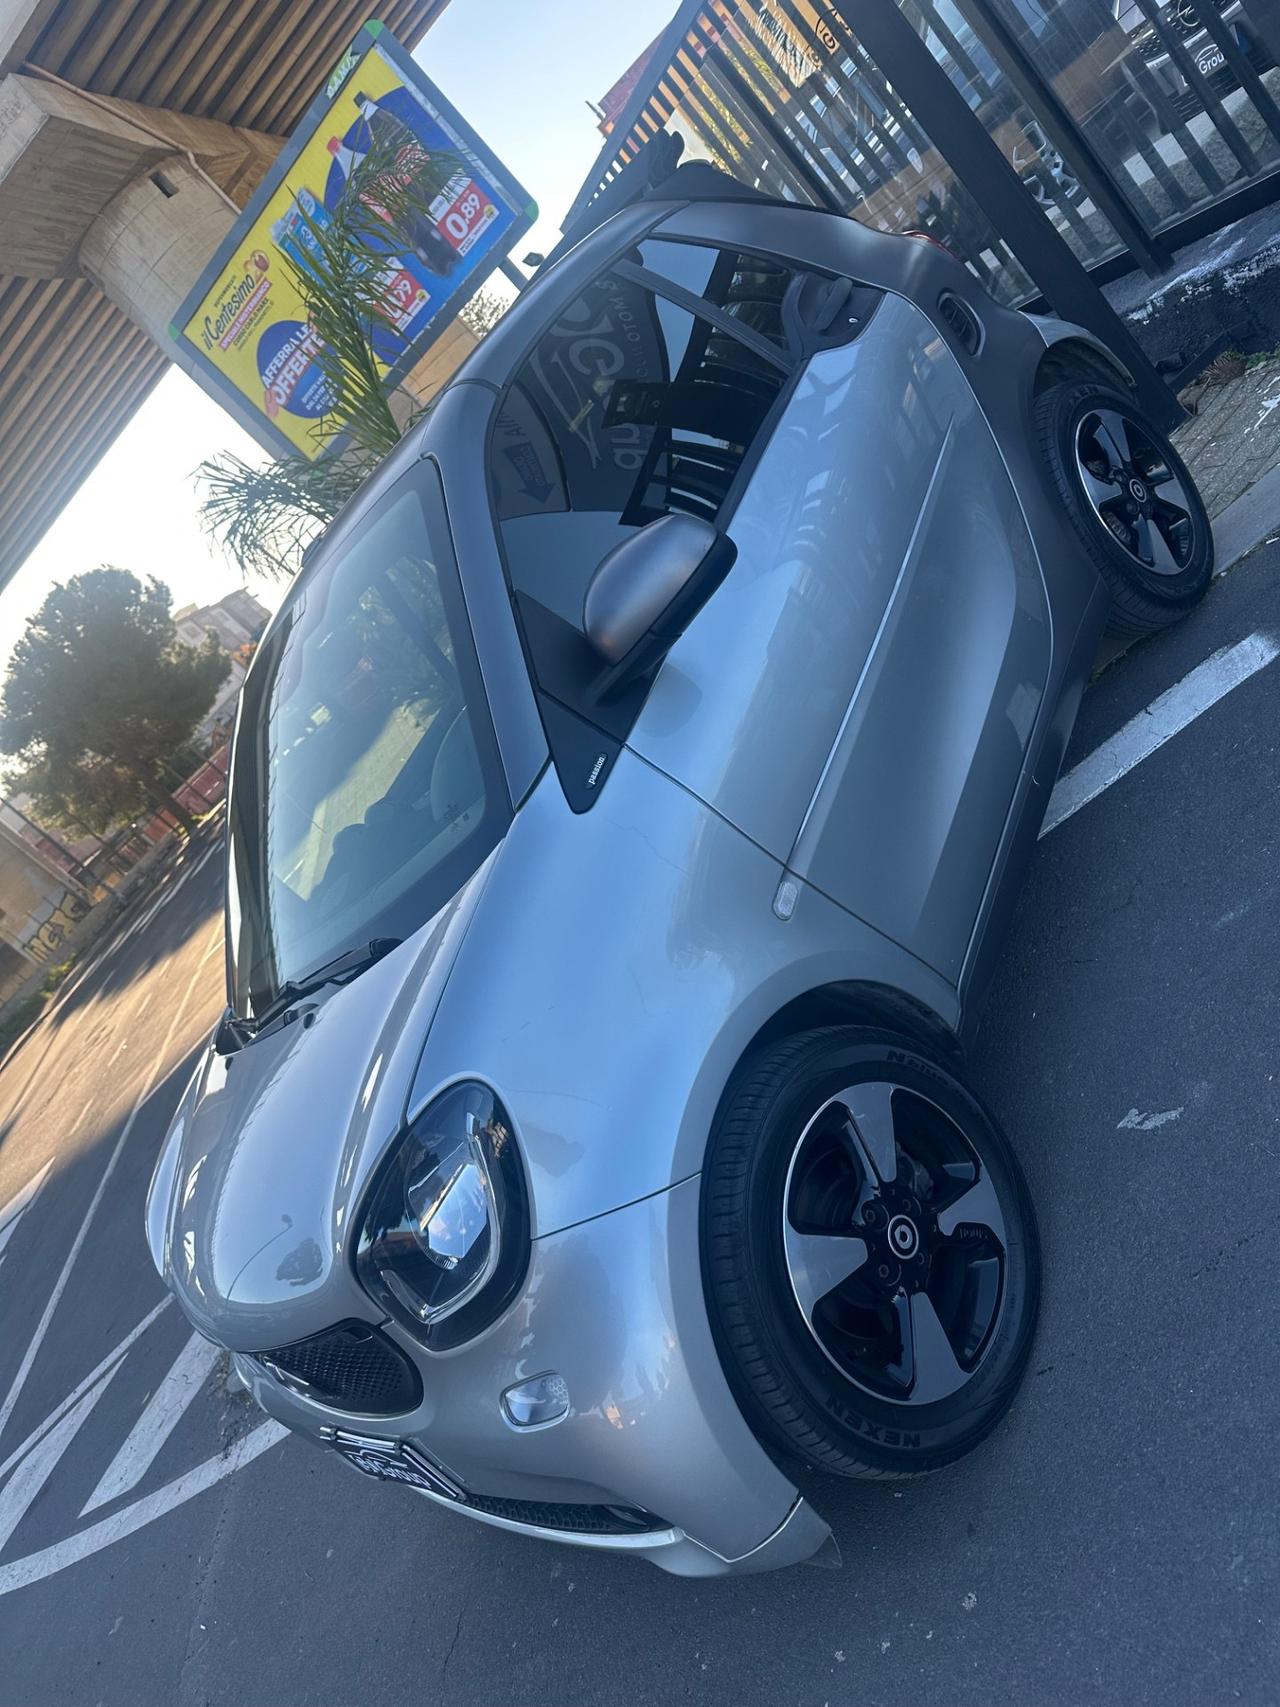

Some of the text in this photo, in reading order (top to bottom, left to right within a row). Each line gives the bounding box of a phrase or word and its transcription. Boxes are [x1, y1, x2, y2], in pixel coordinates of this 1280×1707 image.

[446, 192, 481, 240] 0,89
[261, 324, 311, 388] AFFERRA LE
[274, 332, 325, 405] OFFERTE
[588, 756, 605, 785] passion
[826, 1393, 921, 1449] NEXEN
